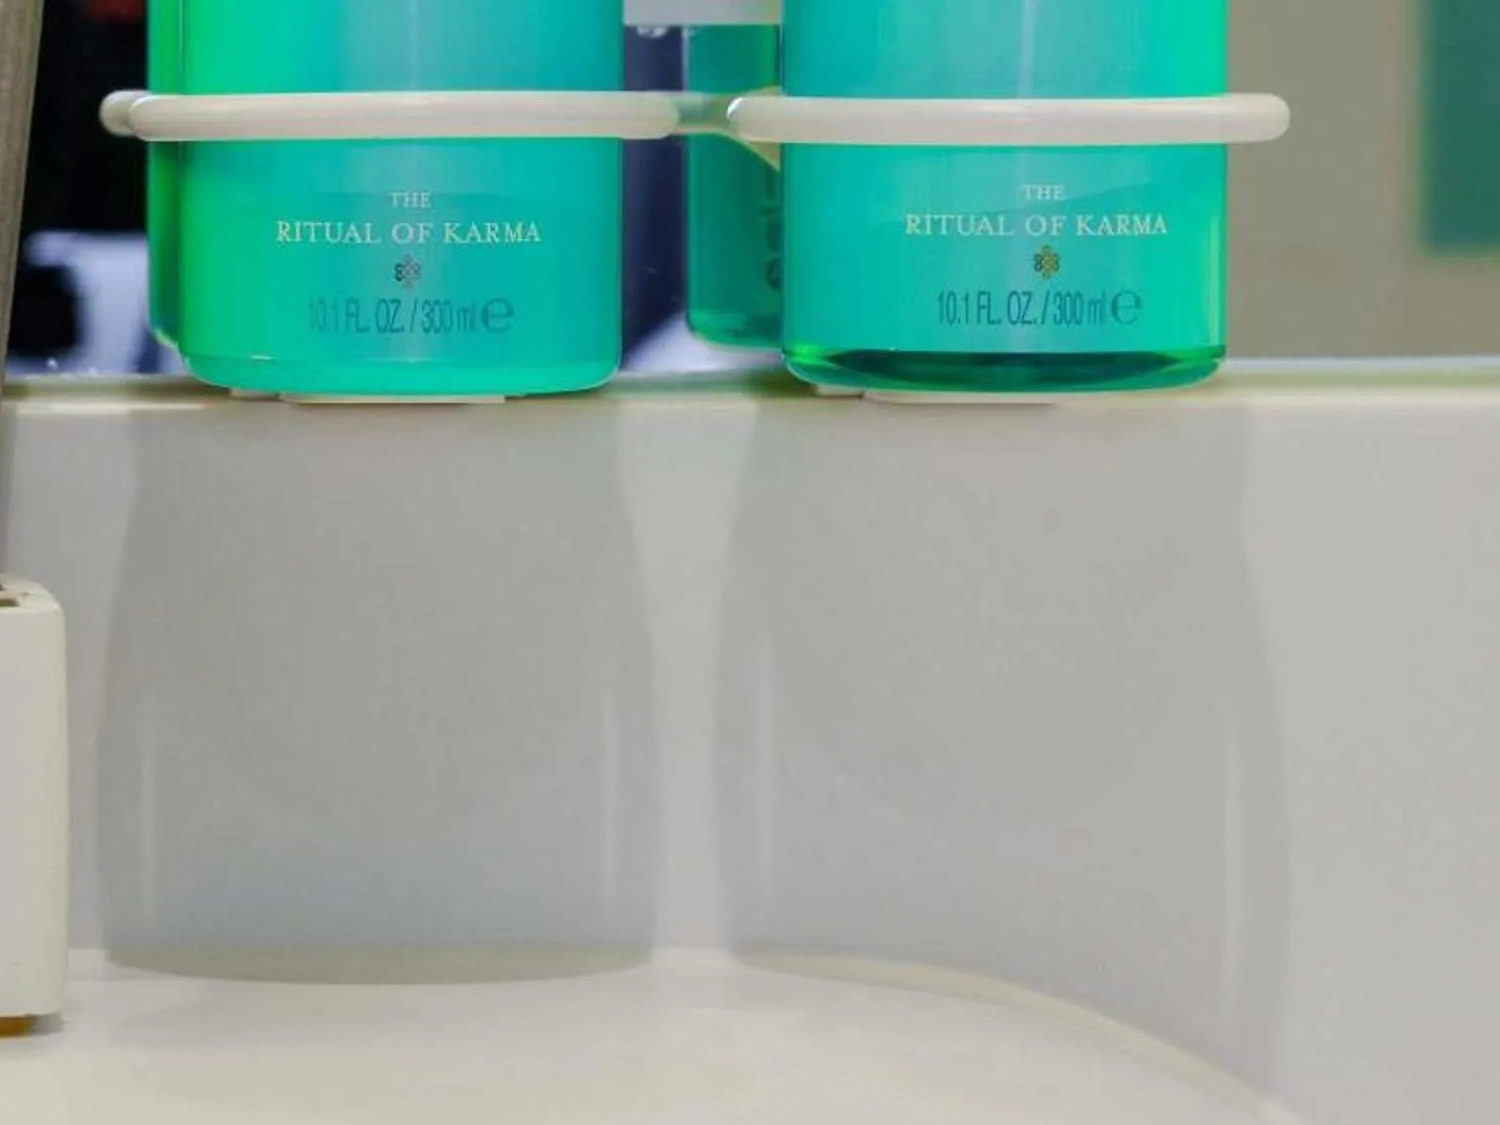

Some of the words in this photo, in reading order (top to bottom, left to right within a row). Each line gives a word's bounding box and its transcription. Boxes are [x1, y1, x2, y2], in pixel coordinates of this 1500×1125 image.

[388, 192, 432, 209] THE
[1022, 183, 1065, 201] THE
[275, 220, 383, 244] RITUAL
[390, 222, 436, 244] OF
[443, 220, 541, 244] KARMA
[904, 213, 1014, 236] RITUAL
[1025, 213, 1067, 236] OF
[1075, 213, 1168, 236] KARMA
[937, 290, 970, 326] 10.1
